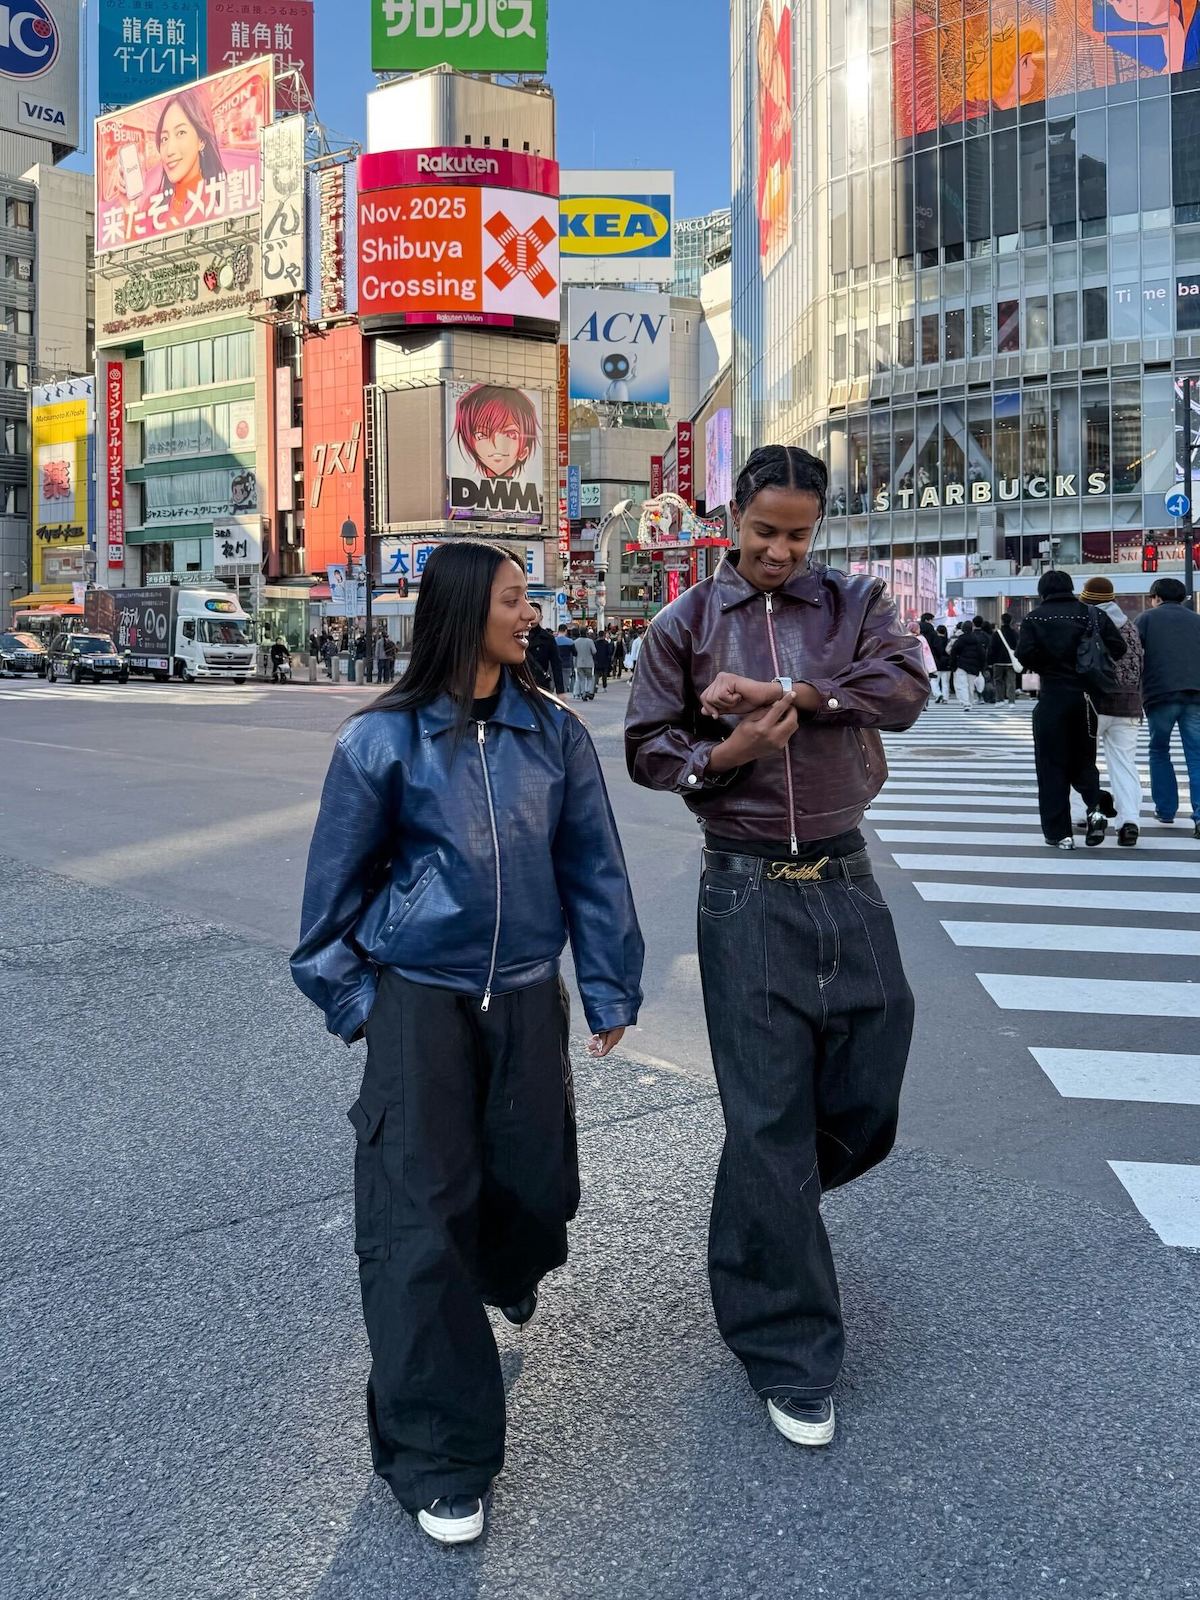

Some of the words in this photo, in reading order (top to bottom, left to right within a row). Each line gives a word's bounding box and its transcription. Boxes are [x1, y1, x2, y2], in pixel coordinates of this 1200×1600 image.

[122, 16, 186, 45] 龍角散
[382, 0, 537, 39] サロンパス
[231, 21, 294, 50] 龍角散
[113, 46, 198, 75] ダイレクト
[21, 101, 66, 126] VISA
[416, 153, 499, 177] Rakuten
[559, 213, 658, 238] KEA
[674, 218, 706, 232] PARCO
[362, 237, 463, 264] Shibuya
[361, 271, 477, 302] Crossing
[571, 311, 668, 345] ACN
[679, 430, 690, 491] カラオケ
[450, 476, 543, 514] DMM
[876, 472, 1107, 512] STARBUCKS
